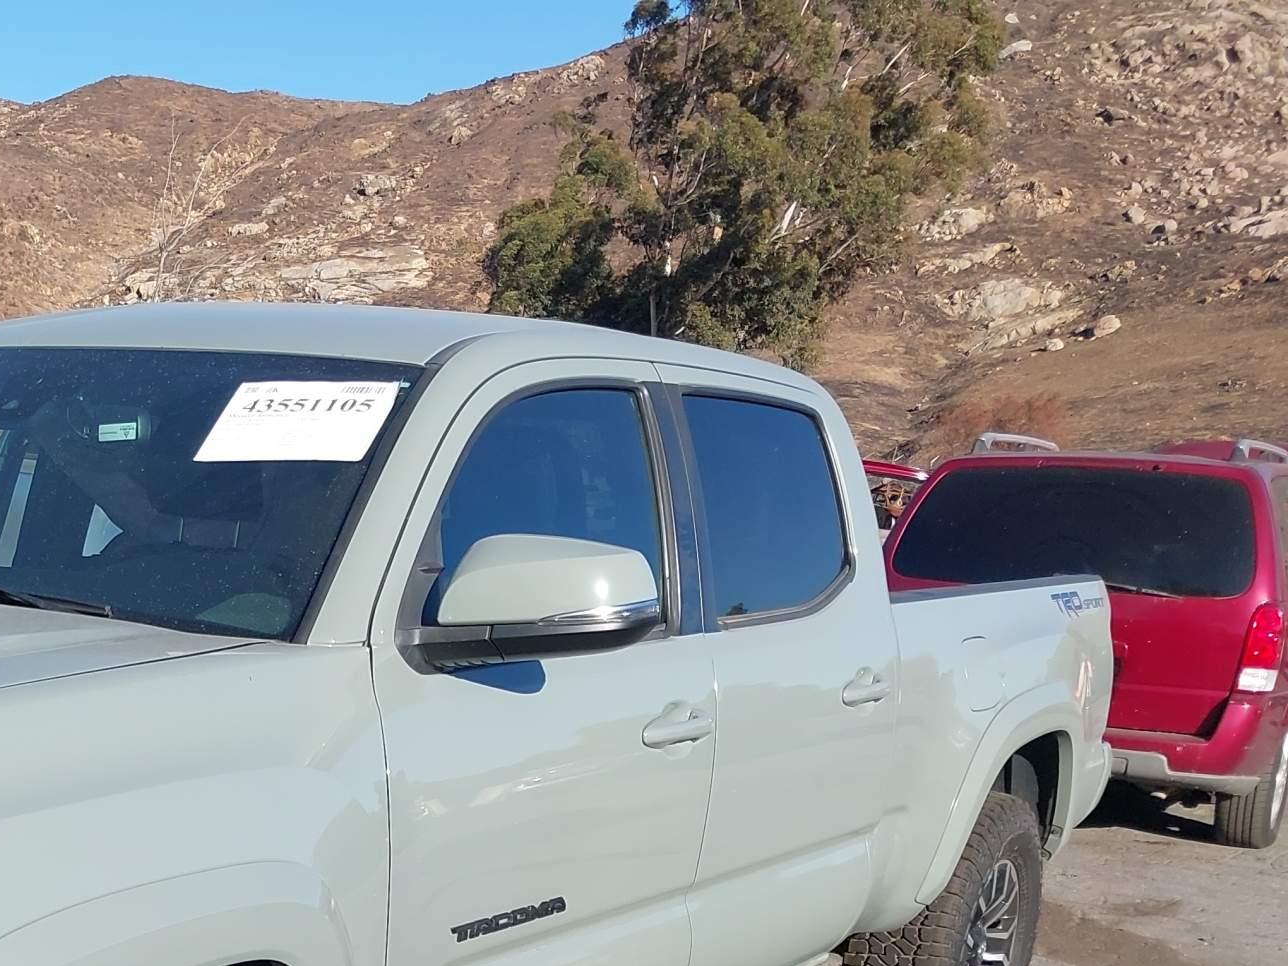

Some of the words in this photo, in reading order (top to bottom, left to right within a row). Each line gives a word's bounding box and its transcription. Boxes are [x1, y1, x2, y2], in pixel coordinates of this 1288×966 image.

[242, 398, 376, 413] 43551105
[1050, 591, 1083, 617] TRD
[1083, 597, 1105, 610] SPORT
[450, 896, 566, 943] TACOMA
